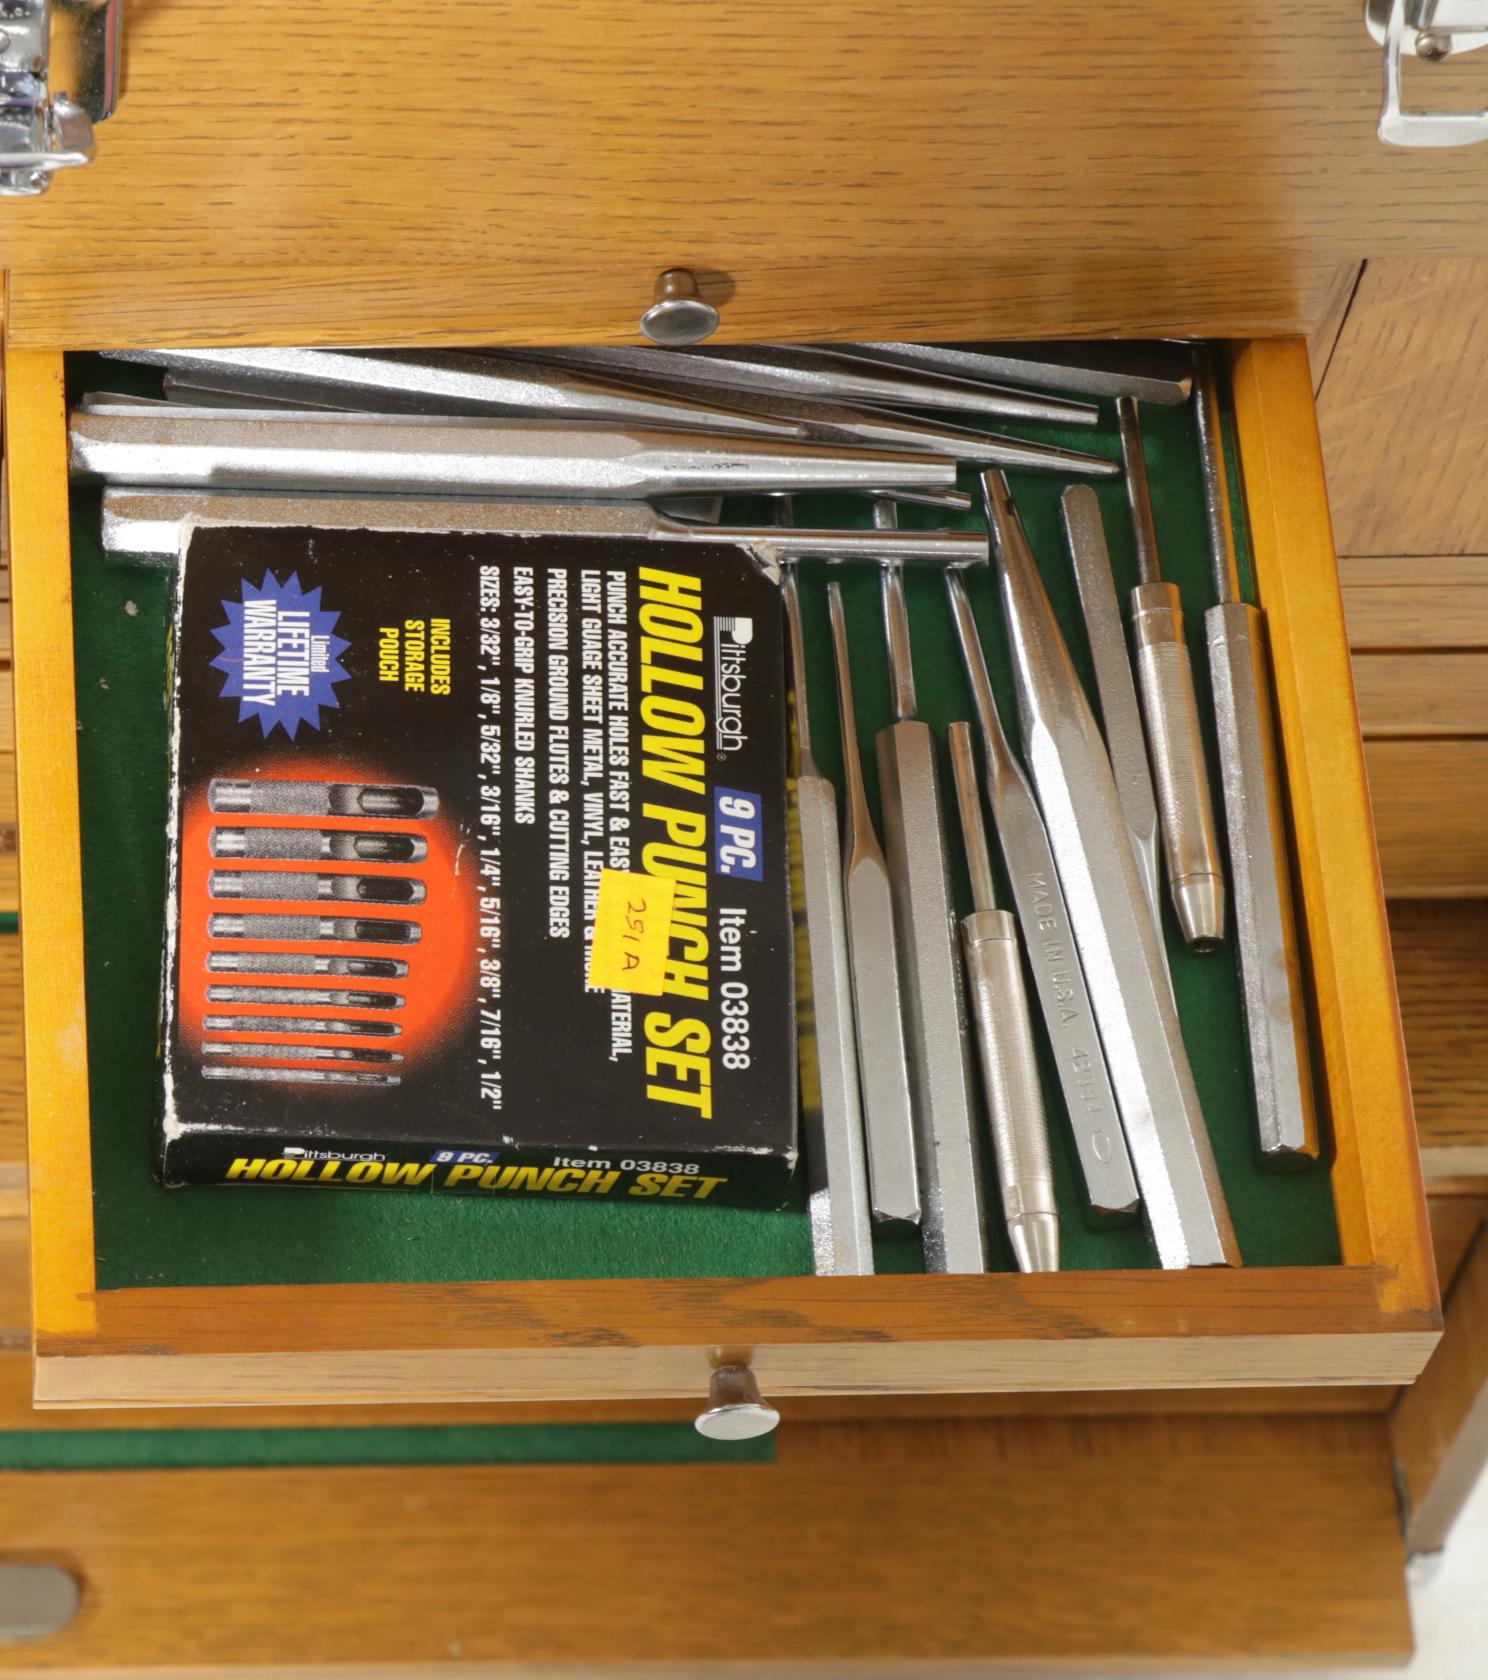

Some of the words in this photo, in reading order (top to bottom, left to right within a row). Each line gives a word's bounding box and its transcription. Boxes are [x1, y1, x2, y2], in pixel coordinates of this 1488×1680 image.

[479, 565, 500, 613] SIZES:
[548, 568, 568, 650] PRECISION
[581, 569, 601, 613] LIGHT
[607, 571, 627, 624] PUNCH
[514, 567, 534, 674] EASY-TO-GRIP
[582, 618, 602, 670] GUAGE
[243, 600, 277, 706] WARRANTY
[277, 611, 310, 696] LIFETIME
[311, 635, 330, 672] Limited
[379, 627, 399, 682] POUCH
[404, 619, 425, 692] STORAGE
[431, 618, 450, 695] INCLUDES
[608, 629, 628, 711] ACCURATE
[639, 566, 706, 795] HOLLOW
[548, 655, 569, 721] GROUND
[582, 674, 603, 724] SHEET
[713, 616, 754, 752] Pittsburgh
[514, 678, 535, 751] KNURLED
[608, 716, 629, 766] HOLES
[549, 725, 569, 785] FLUTES
[580, 729, 603, 786] METAL,
[515, 756, 535, 824] SHANKS
[549, 790, 569, 804] &
[609, 770, 630, 812] FAST
[719, 797, 756, 819] 9
[549, 809, 569, 881] CUTTING
[580, 793, 603, 845] VINYL,
[609, 817, 630, 832] &
[609, 837, 631, 873] EAS
[719, 825, 757, 874] PC.
[549, 886, 570, 938] EDGES
[584, 852, 603, 920] LEATHER
[642, 803, 710, 1001] PUNCH
[719, 908, 747, 972] Item
[1026, 872, 1058, 931] MADE
[1043, 939, 1064, 962] IN
[720, 982, 751, 1070] 03838
[644, 1011, 712, 1119] SET
[225, 1158, 438, 1185] HOLLOW
[443, 1164, 621, 1194] PUNCH
[628, 1173, 728, 1199] SET
[282, 1147, 386, 1161] Pittsburgh
[436, 1151, 450, 1162] 9
[457, 1151, 493, 1164] PC.
[553, 1156, 611, 1169] Item
[620, 1159, 700, 1174] 03838
